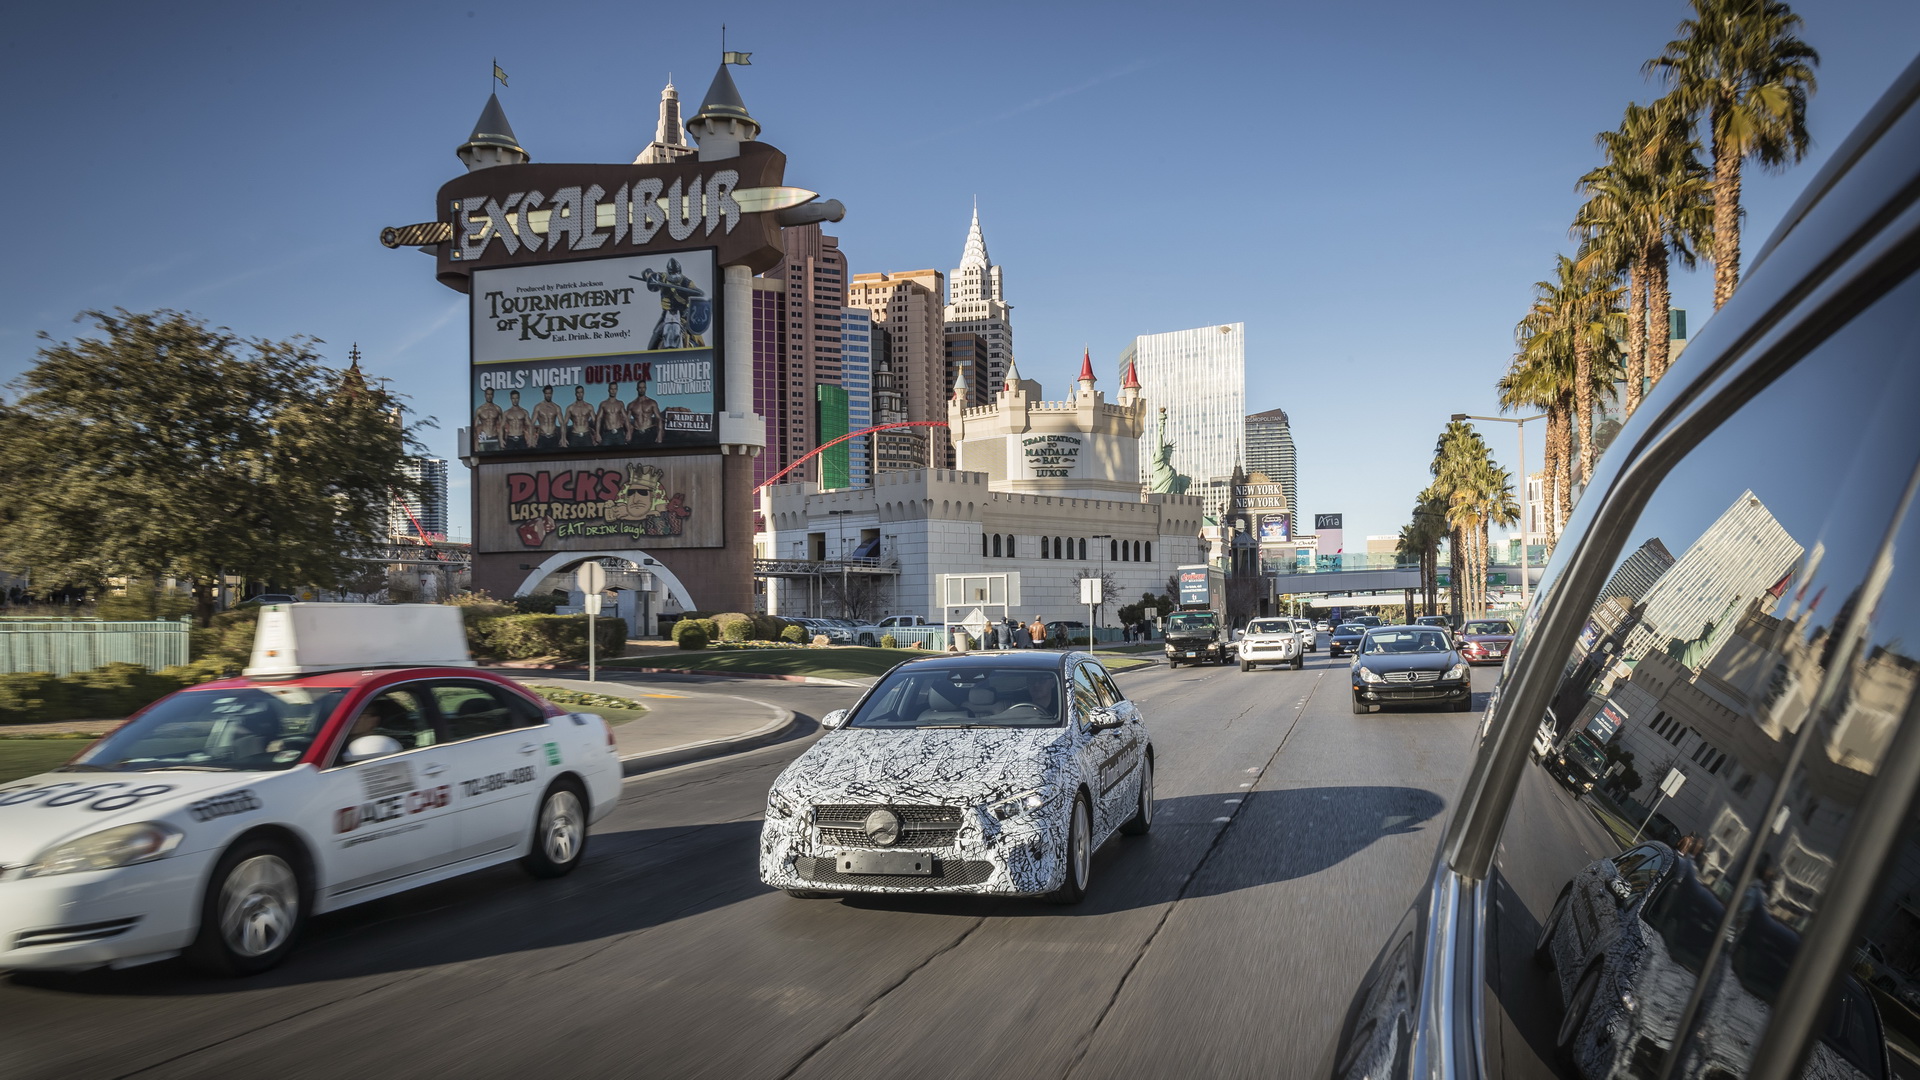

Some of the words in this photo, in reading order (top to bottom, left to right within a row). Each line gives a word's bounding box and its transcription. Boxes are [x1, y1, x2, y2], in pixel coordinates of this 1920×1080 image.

[460, 169, 741, 260] EXCALIBUR
[516, 285, 546, 293] Produced
[547, 284, 554, 292] by
[555, 281, 577, 290] Patrick
[484, 287, 635, 318] TOURNAMENT
[518, 311, 621, 341] KINGS
[552, 334, 567, 342] Eat.
[568, 332, 592, 341] Drink.
[604, 329, 631, 339] Rowdy!
[480, 369, 529, 391] GIRLS'
[532, 366, 582, 388] NIGHT
[585, 362, 652, 385] OUTBACK
[655, 361, 711, 382] THUNDER
[656, 382, 683, 395] DOWN
[684, 380, 711, 394] UNDER
[668, 420, 709, 429] AUSTRALIA
[674, 413, 694, 421] MADE
[696, 414, 704, 422] IN
[1022, 436, 1046, 446] TRAM
[1047, 435, 1081, 446] STATION
[1025, 448, 1079, 456] MANDALAY
[1042, 456, 1061, 464] BAY
[1036, 469, 1069, 478] LUXOR
[508, 469, 622, 503] DICK'S
[1235, 485, 1255, 496] NEW
[1256, 484, 1280, 495] YORK
[1236, 497, 1256, 508] NEW
[1256, 496, 1281, 507] YORK
[510, 503, 548, 521] LAST
[551, 502, 607, 520] RESORT
[558, 522, 585, 537] EAT
[586, 524, 618, 536] DRINK
[620, 523, 646, 539] laugh
